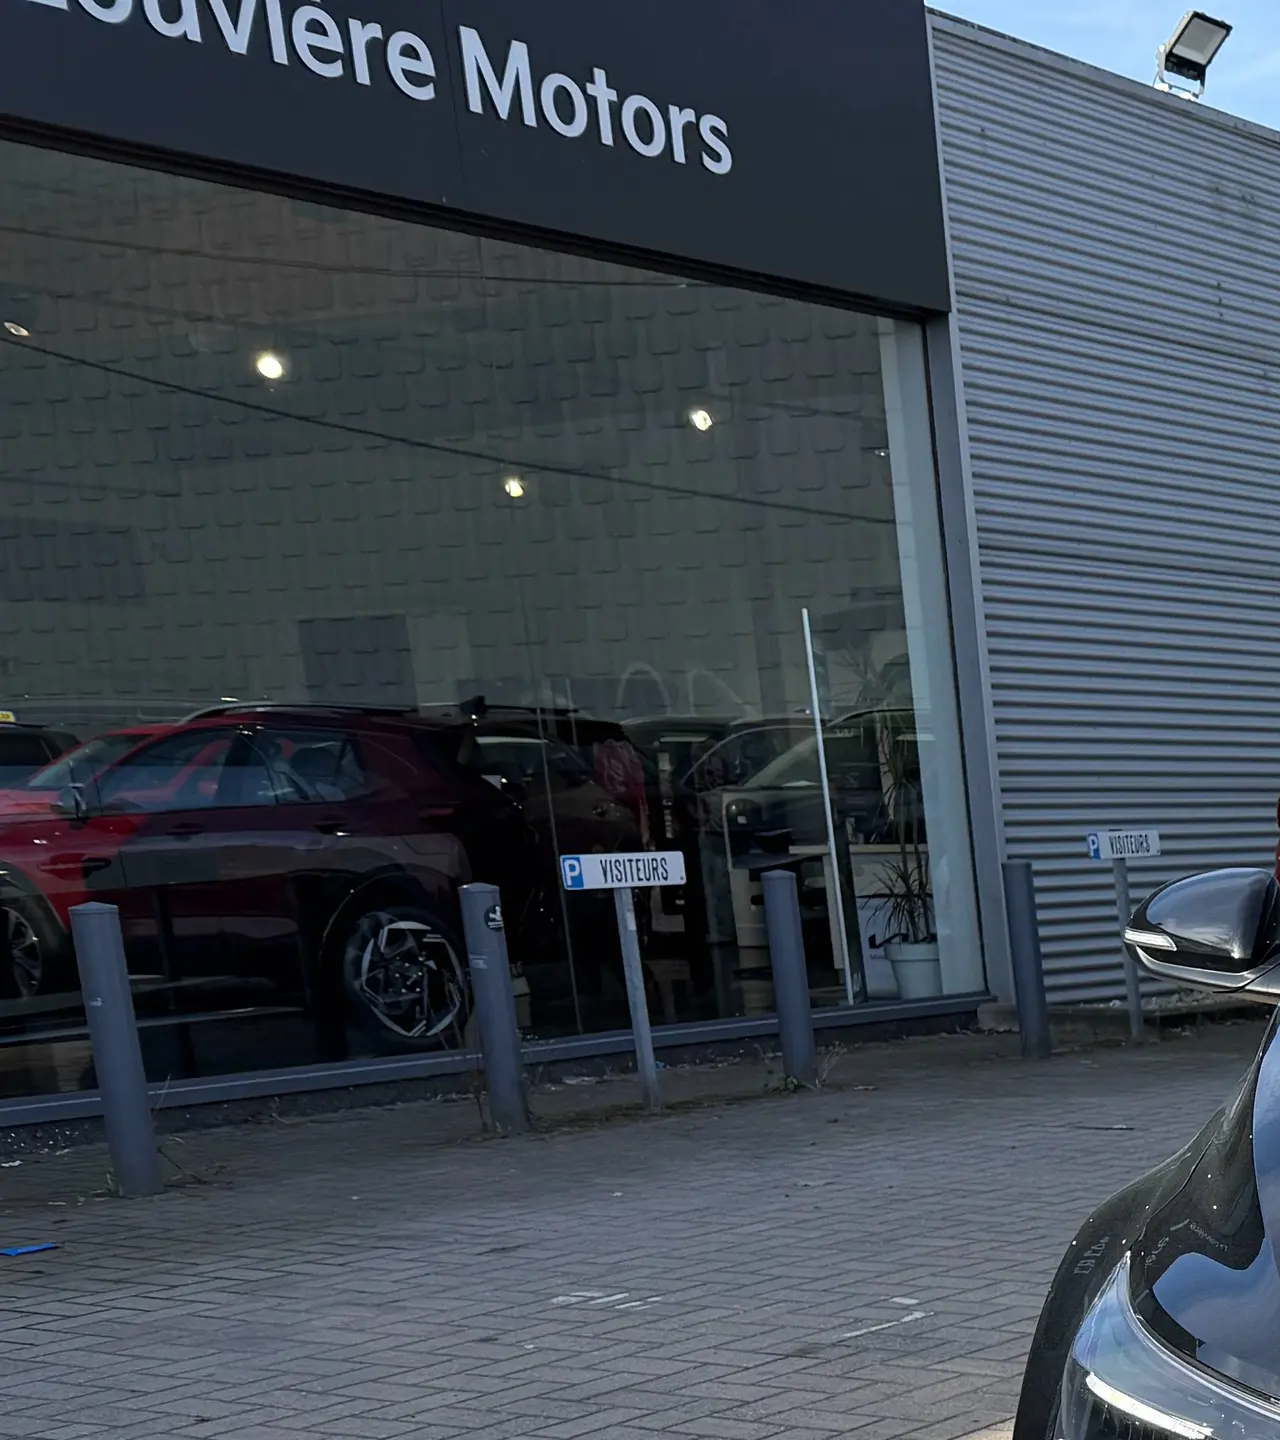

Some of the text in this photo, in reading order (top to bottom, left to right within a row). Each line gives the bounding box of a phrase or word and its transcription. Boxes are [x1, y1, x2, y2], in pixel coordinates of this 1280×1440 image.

[459, 24, 733, 175] Motors
[1108, 833, 1151, 855] VISITEURS
[564, 857, 669, 886] P VISITEURS
